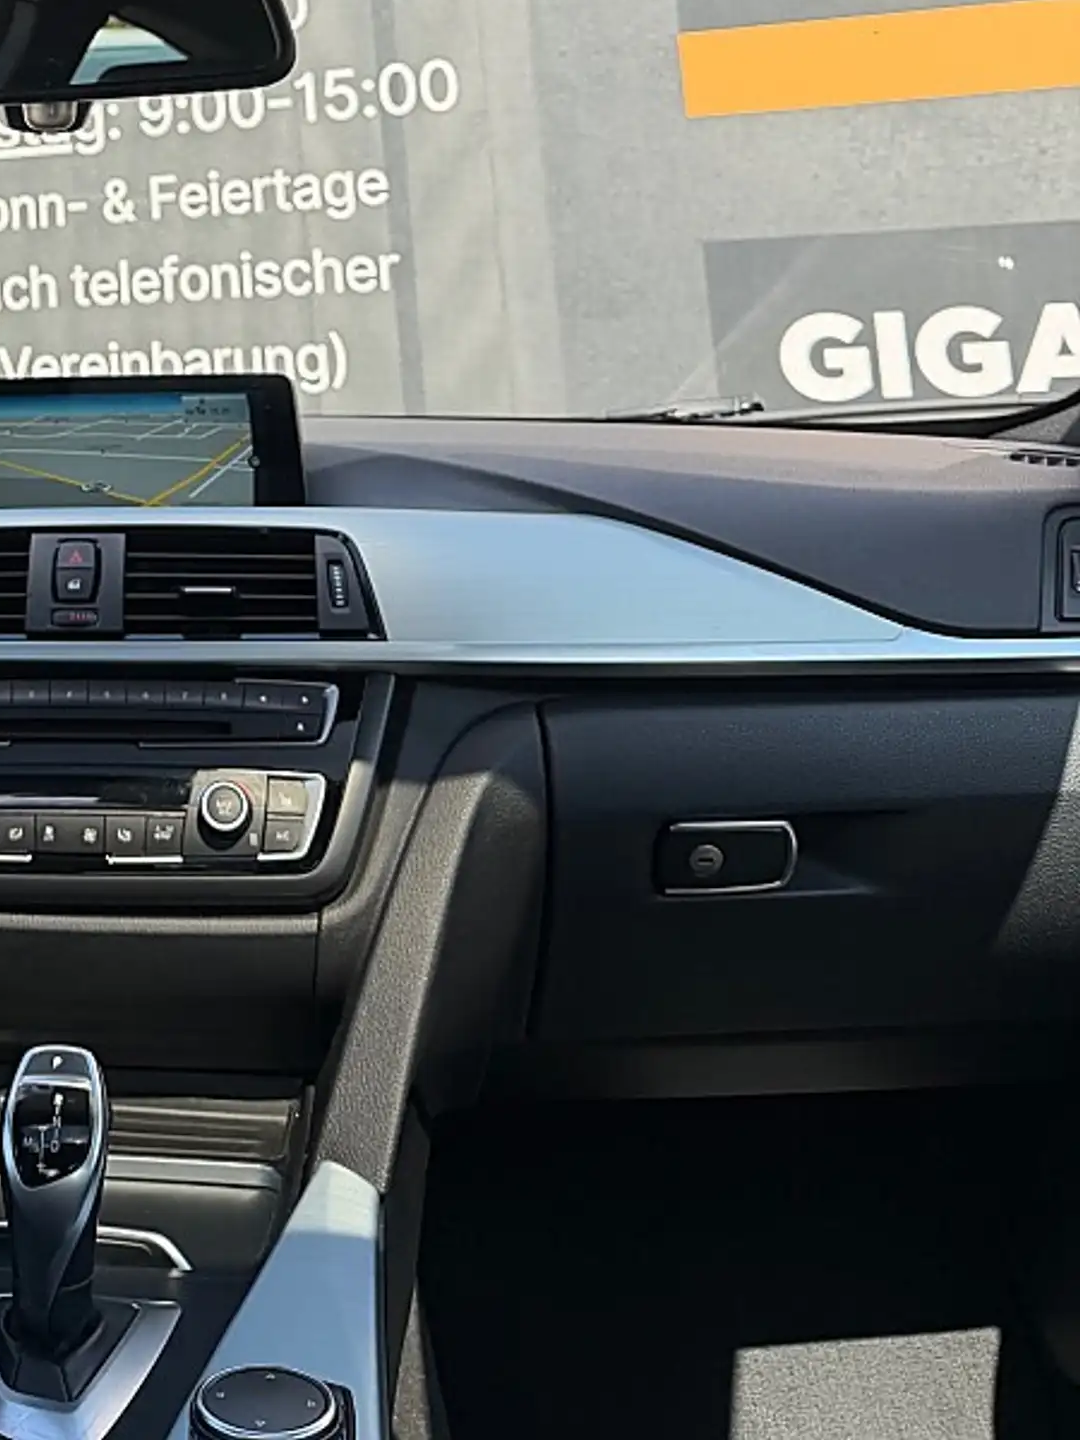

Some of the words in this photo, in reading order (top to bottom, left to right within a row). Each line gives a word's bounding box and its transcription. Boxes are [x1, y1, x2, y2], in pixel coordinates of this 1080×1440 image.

[139, 58, 460, 138] 9:00-15:00
[103, 177, 137, 224] &
[150, 168, 390, 220] Feiertage
[70, 248, 401, 308] telefonischer
[778, 302, 1080, 402] GIGA
